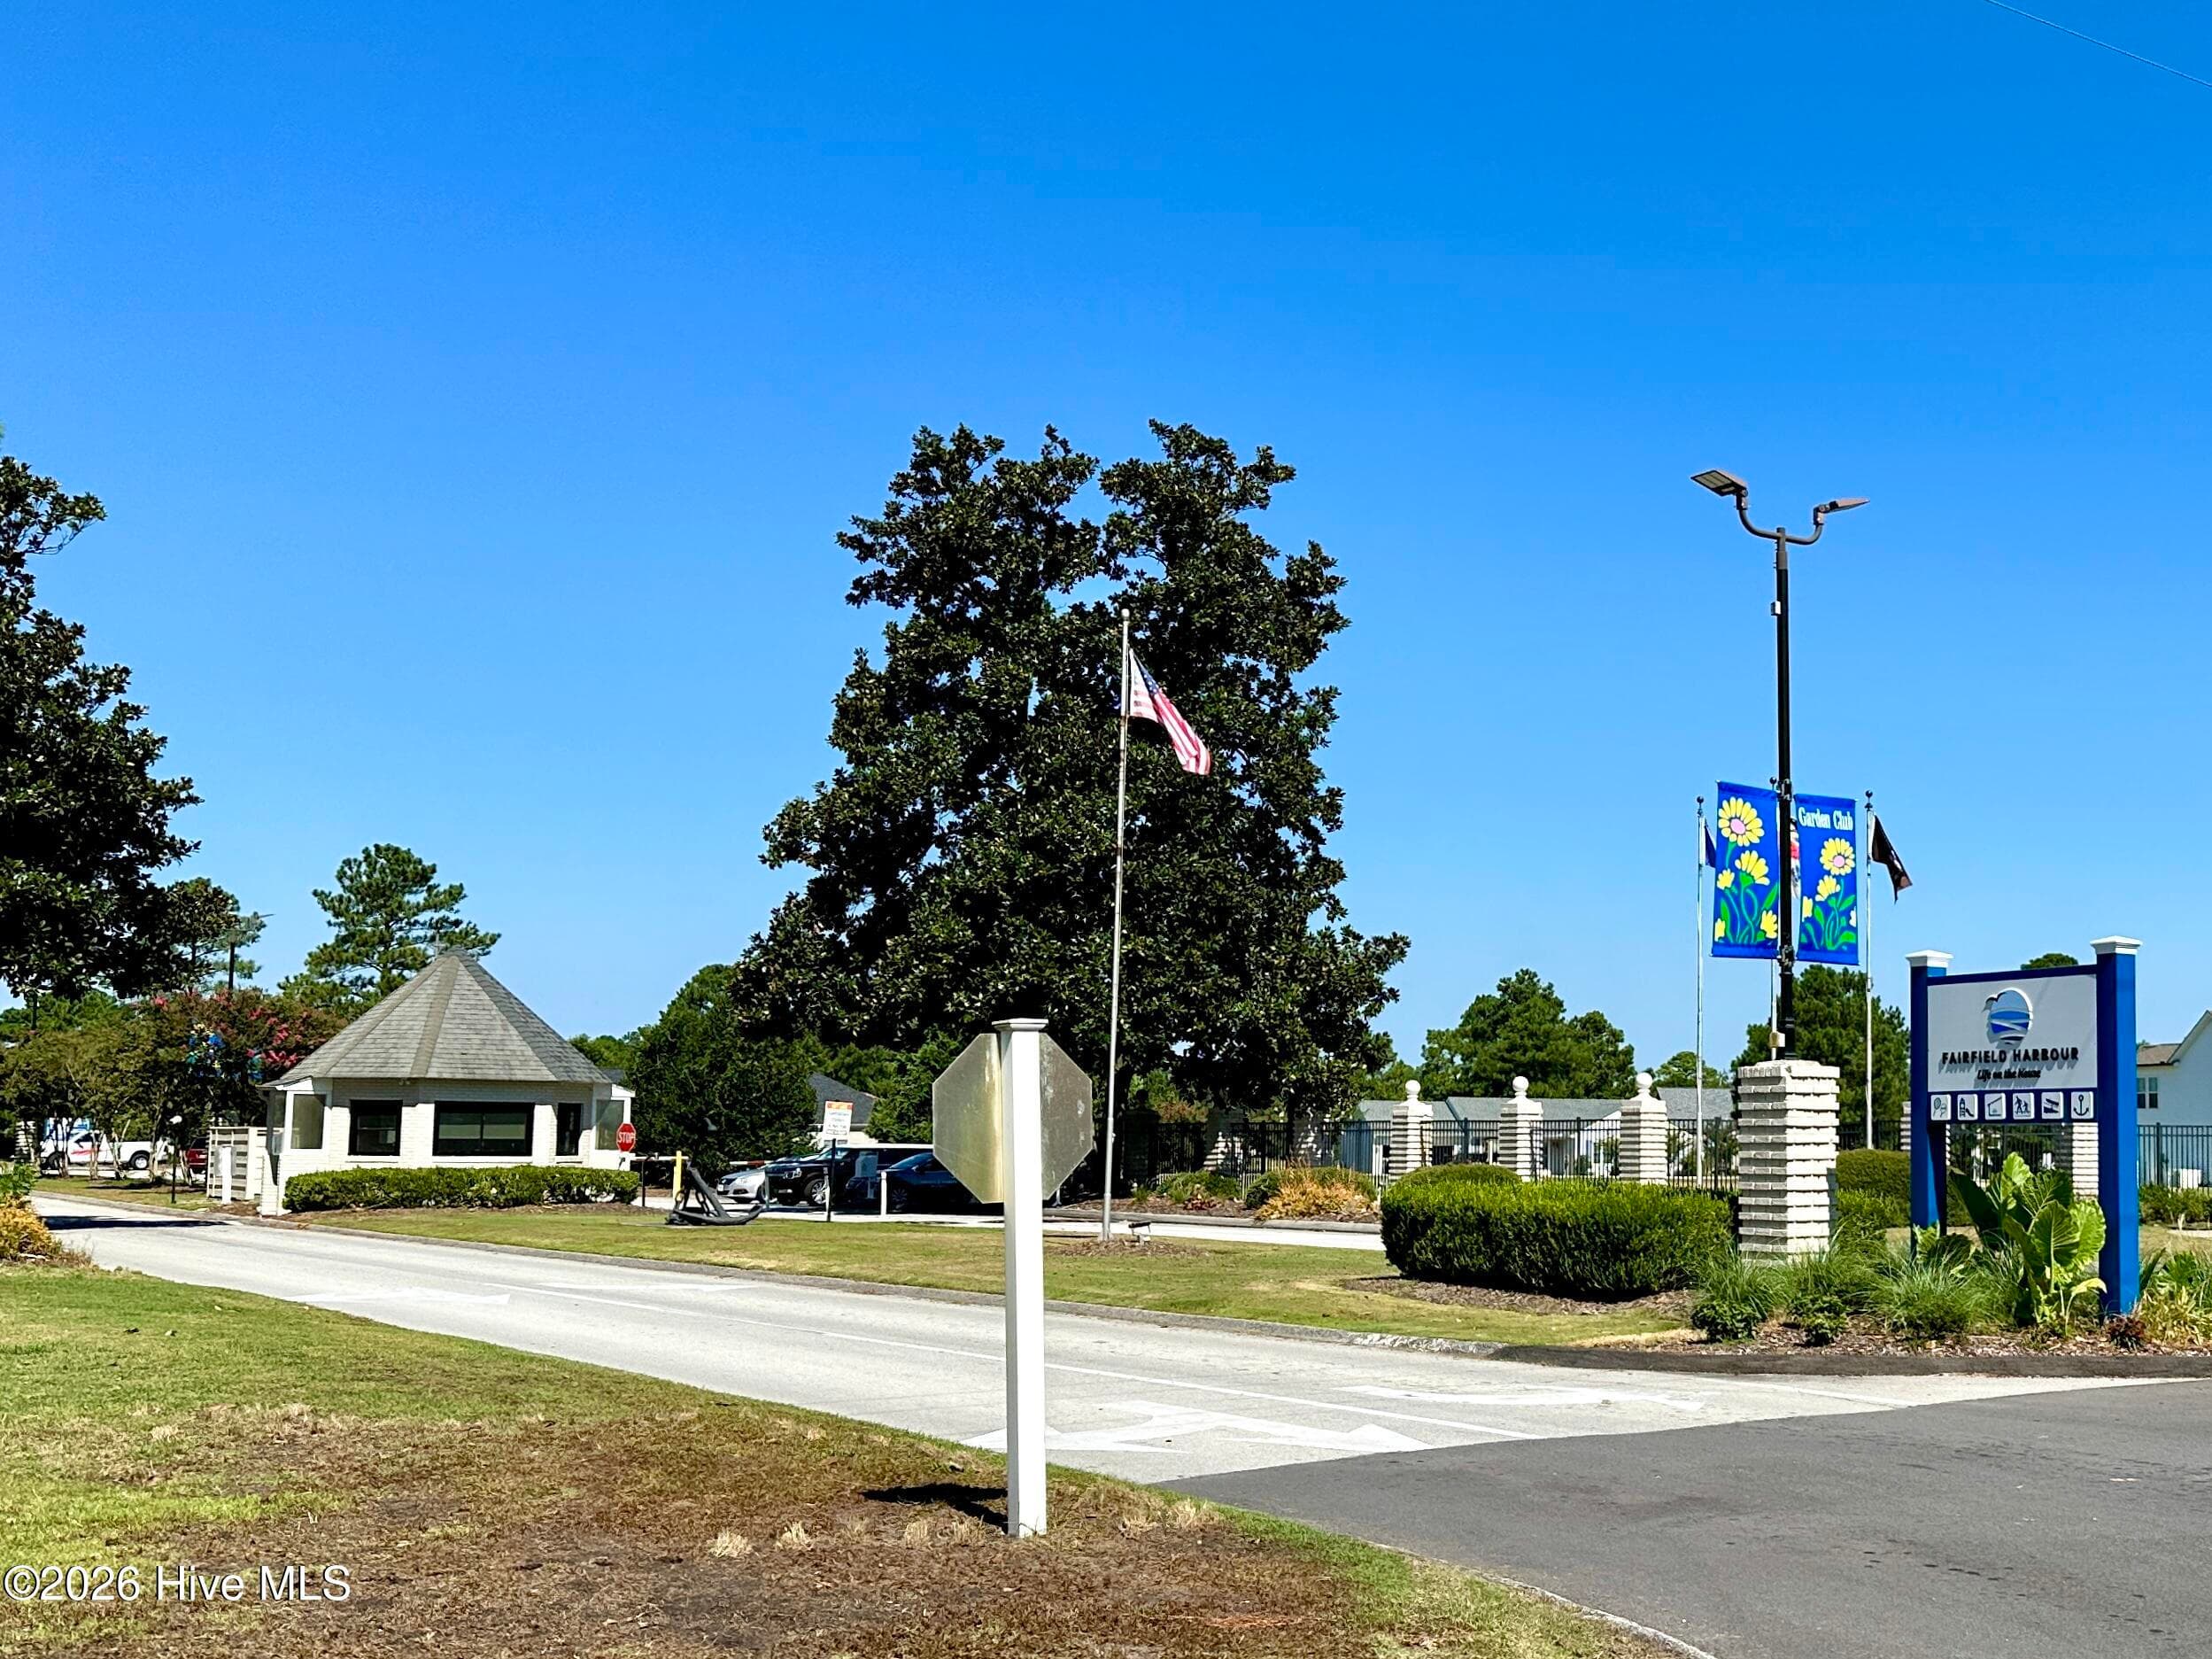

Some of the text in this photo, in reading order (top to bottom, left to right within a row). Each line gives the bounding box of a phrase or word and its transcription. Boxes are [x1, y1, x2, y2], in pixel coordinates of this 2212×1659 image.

[1798, 806, 1853, 831] Garden Club
[1942, 1047, 2079, 1065] FAIRFIELD HARBOUR
[1977, 1069, 1992, 1082] Life
[2004, 1068, 2017, 1079] the
[617, 1131, 635, 1143] STOP
